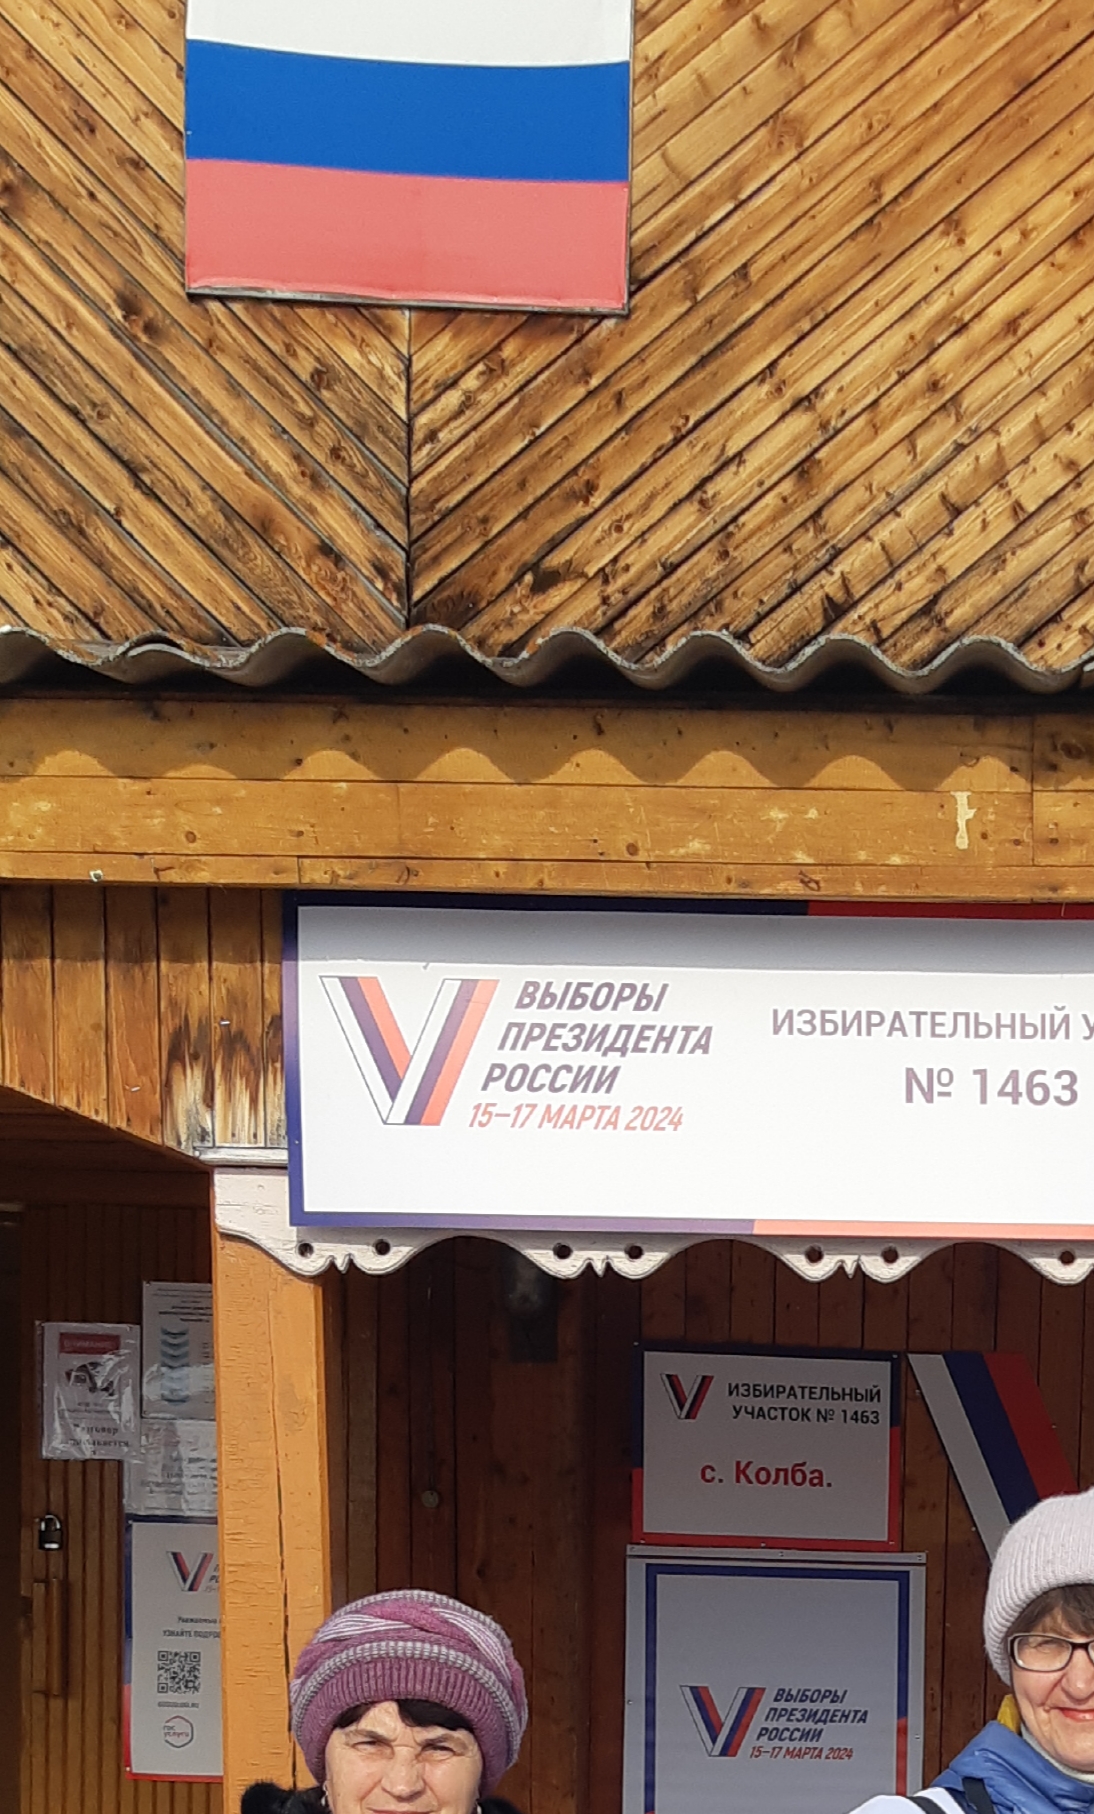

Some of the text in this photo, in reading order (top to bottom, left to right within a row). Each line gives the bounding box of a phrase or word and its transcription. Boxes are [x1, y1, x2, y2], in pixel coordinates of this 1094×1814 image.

[515, 980, 669, 1013] ВЫБОРЫ
[772, 1005, 1071, 1041] ИЗБИРАТЕЛЬНЫЙ
[498, 1022, 713, 1058] ПРЕЗИДЕНТА
[481, 1063, 621, 1095] РОССИИ
[904, 1066, 1080, 1107] № 1463
[537, 1104, 619, 1132] МАРТА
[625, 1105, 684, 1133] 2024
[728, 1383, 881, 1403] ИЗБИРАТЕЛЬНЫЙ
[732, 1405, 880, 1425] УЧАСТОК № 1463
[700, 1460, 832, 1487] с. Колба.
[773, 1687, 847, 1705] ВЫБОРЫ
[764, 1707, 868, 1726] ПРЕЗИДЕНТА
[756, 1727, 822, 1743] РОССИИ
[783, 1746, 822, 1760] МАРТА
[825, 1747, 853, 1760] 2024
